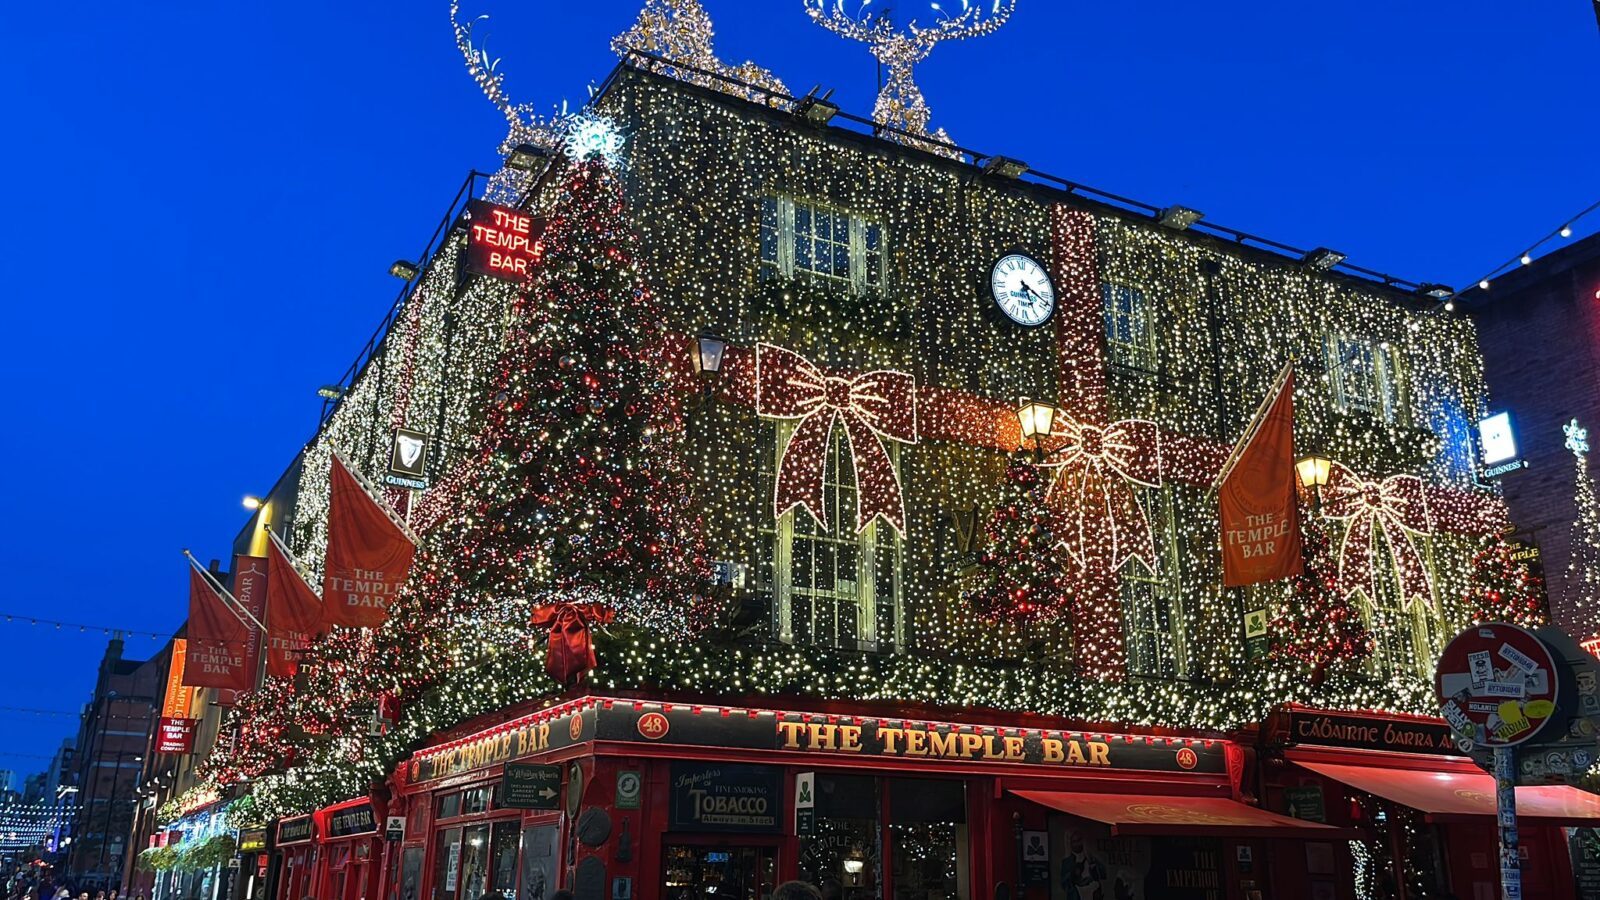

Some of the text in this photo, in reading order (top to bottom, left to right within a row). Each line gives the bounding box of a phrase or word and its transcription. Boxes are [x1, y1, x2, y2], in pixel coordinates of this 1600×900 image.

[493, 210, 530, 233] THE
[473, 225, 544, 256] TEMPLE
[490, 252, 526, 274] BAR
[1010, 290, 1037, 302] GUINNSS
[1484, 461, 1521, 477] GUINNESS
[386, 475, 424, 488] GUINNESS
[1246, 512, 1273, 527] THE
[1227, 519, 1290, 546] TEMPLE
[1242, 541, 1276, 559] BAR
[354, 568, 383, 580] THE
[240, 578, 253, 603] BAR
[348, 594, 387, 608] BAR
[208, 646, 228, 656] THE
[272, 638, 312, 650] TEMP
[192, 652, 242, 666] TEMPLE
[284, 650, 300, 660] BA
[204, 664, 230, 674] BAR
[644, 718, 662, 733] 48
[432, 723, 550, 777] THE TEMPLE BAR
[778, 722, 1112, 766] THE TEMPLE BAR
[1178, 750, 1193, 765] 48
[675, 769, 720, 788] Importers
[733, 786, 767, 794] SMOKING
[688, 789, 767, 819] TOBACCO
[833, 822, 849, 830] THE
[802, 836, 850, 862] TEMPLE
[1167, 870, 1218, 888] EMPEROR
